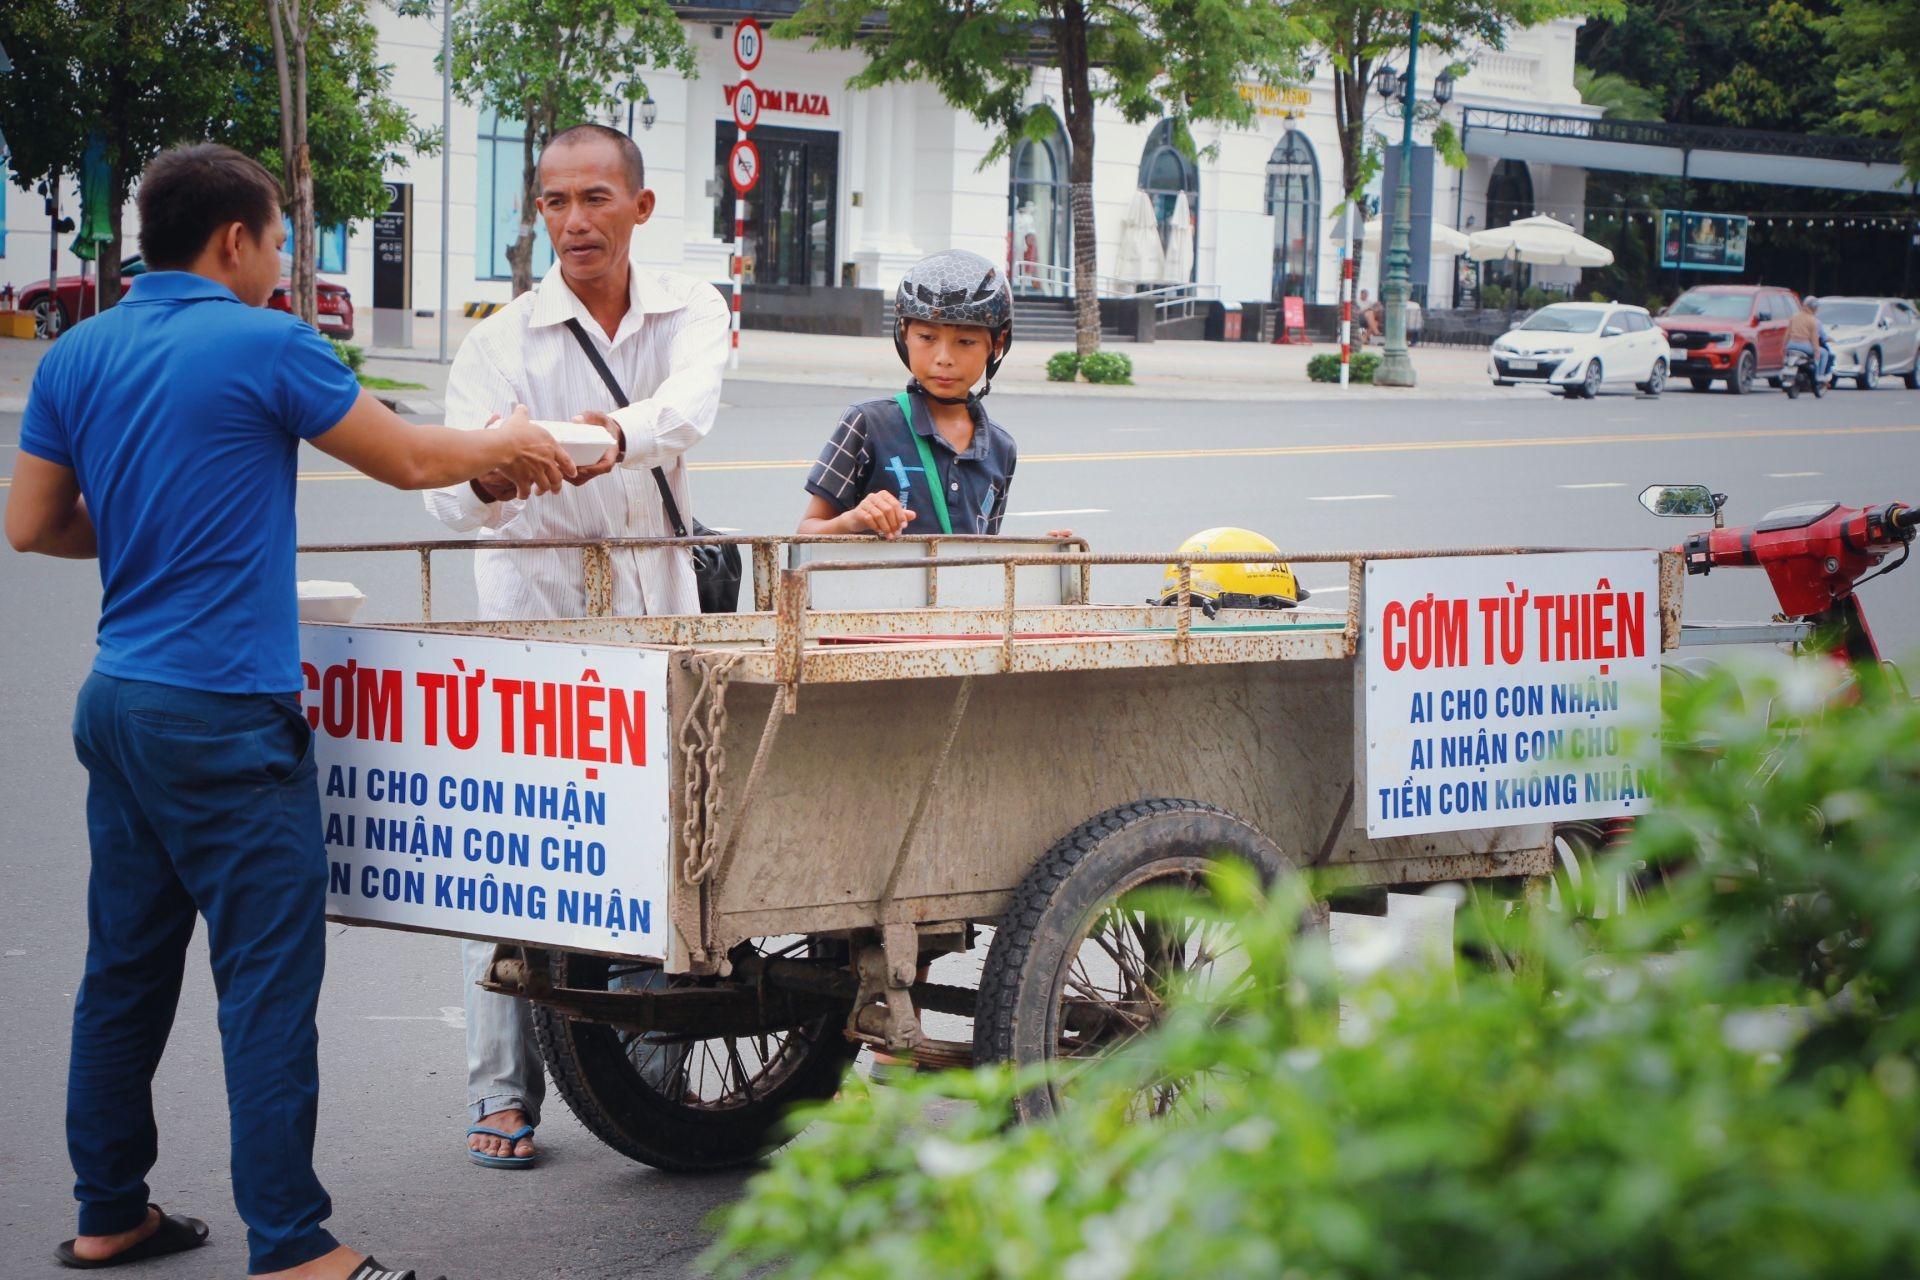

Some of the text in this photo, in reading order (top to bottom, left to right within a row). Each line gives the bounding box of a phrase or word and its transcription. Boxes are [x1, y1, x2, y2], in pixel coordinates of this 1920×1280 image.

[741, 35, 753, 57] 10
[740, 94, 752, 117] 40
[785, 90, 830, 116] PLAZA
[1382, 577, 1646, 675] CƠM TỪ THIỆN
[296, 657, 648, 781] CƠM TỪ THIỆN
[1410, 675, 1620, 724] AI CHO CON NHẬN
[1410, 726, 1620, 773] AI NHẬN CON CHO
[326, 764, 606, 831] AI CHO CON NHẬN
[1379, 775, 1432, 820] TIỀN
[1438, 780, 1488, 816] CON
[1495, 769, 1577, 812] KHÔNG
[324, 812, 606, 877] AI NHẬN CON CHO
[360, 865, 425, 905] CON
[434, 870, 546, 921] KHÔNG
[557, 888, 651, 938] NHẬN
